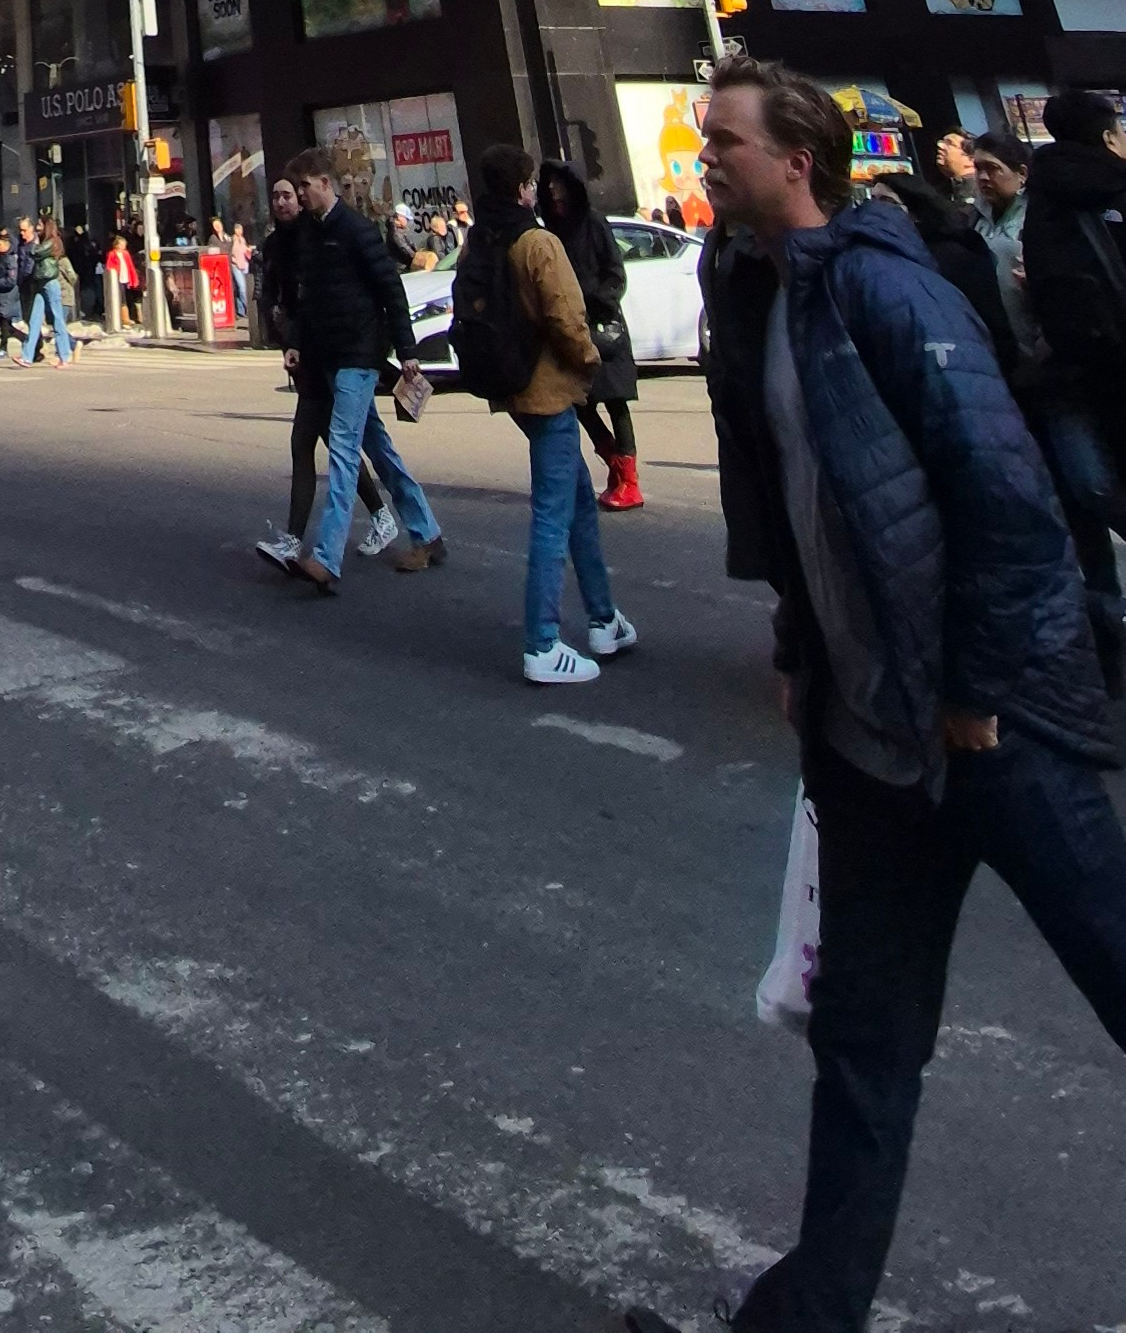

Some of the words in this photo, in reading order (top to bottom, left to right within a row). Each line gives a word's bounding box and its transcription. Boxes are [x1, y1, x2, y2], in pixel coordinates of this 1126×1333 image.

[41, 93, 64, 119] U.S.
[65, 85, 104, 116] POLO
[394, 136, 417, 163] POP
[417, 133, 450, 161] MART
[402, 185, 458, 210] COMING
